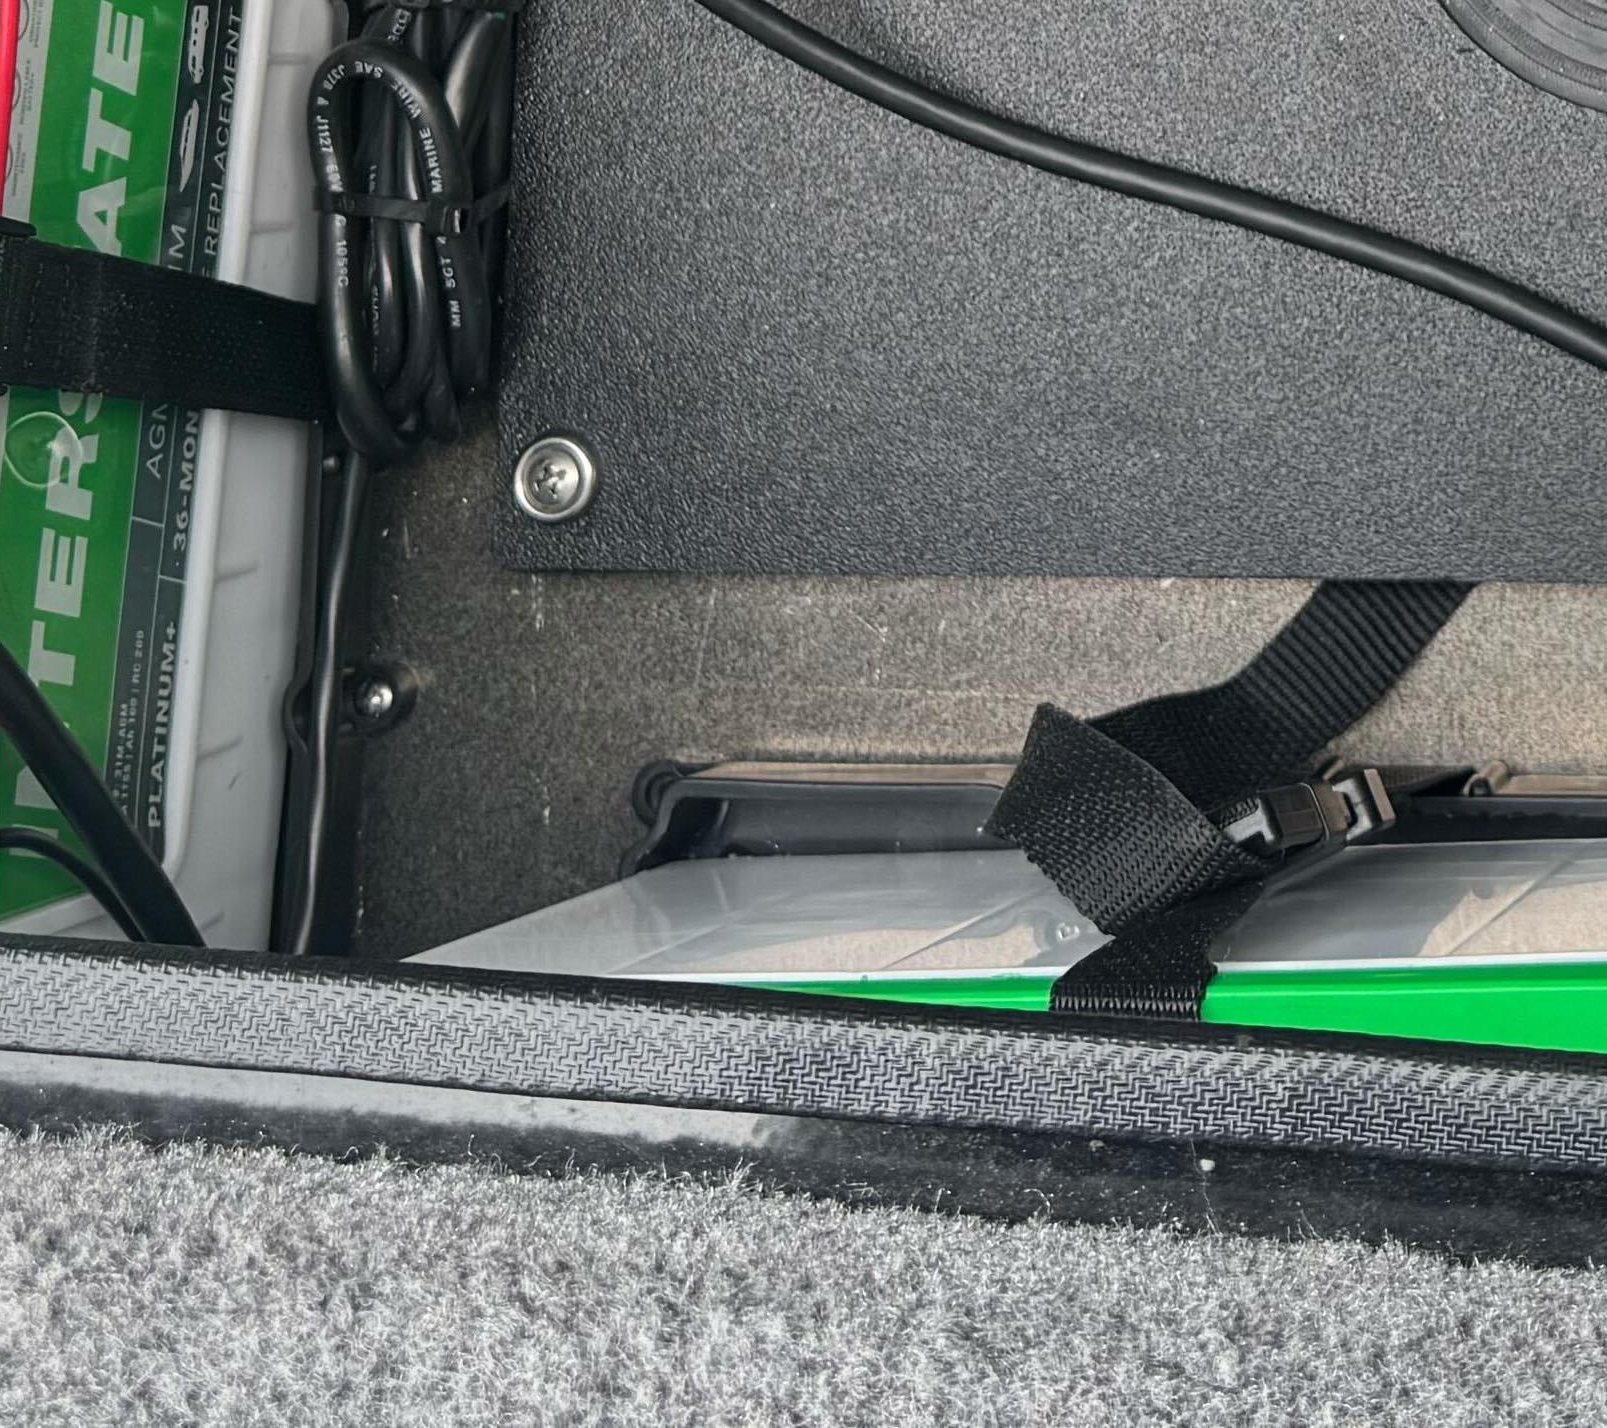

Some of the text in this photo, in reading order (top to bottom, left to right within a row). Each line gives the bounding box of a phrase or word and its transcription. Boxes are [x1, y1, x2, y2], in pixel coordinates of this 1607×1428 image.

[203, 5, 241, 256] REPLACEMENT
[419, 127, 443, 193] MARINE
[147, 620, 177, 828] PLATINUM+
